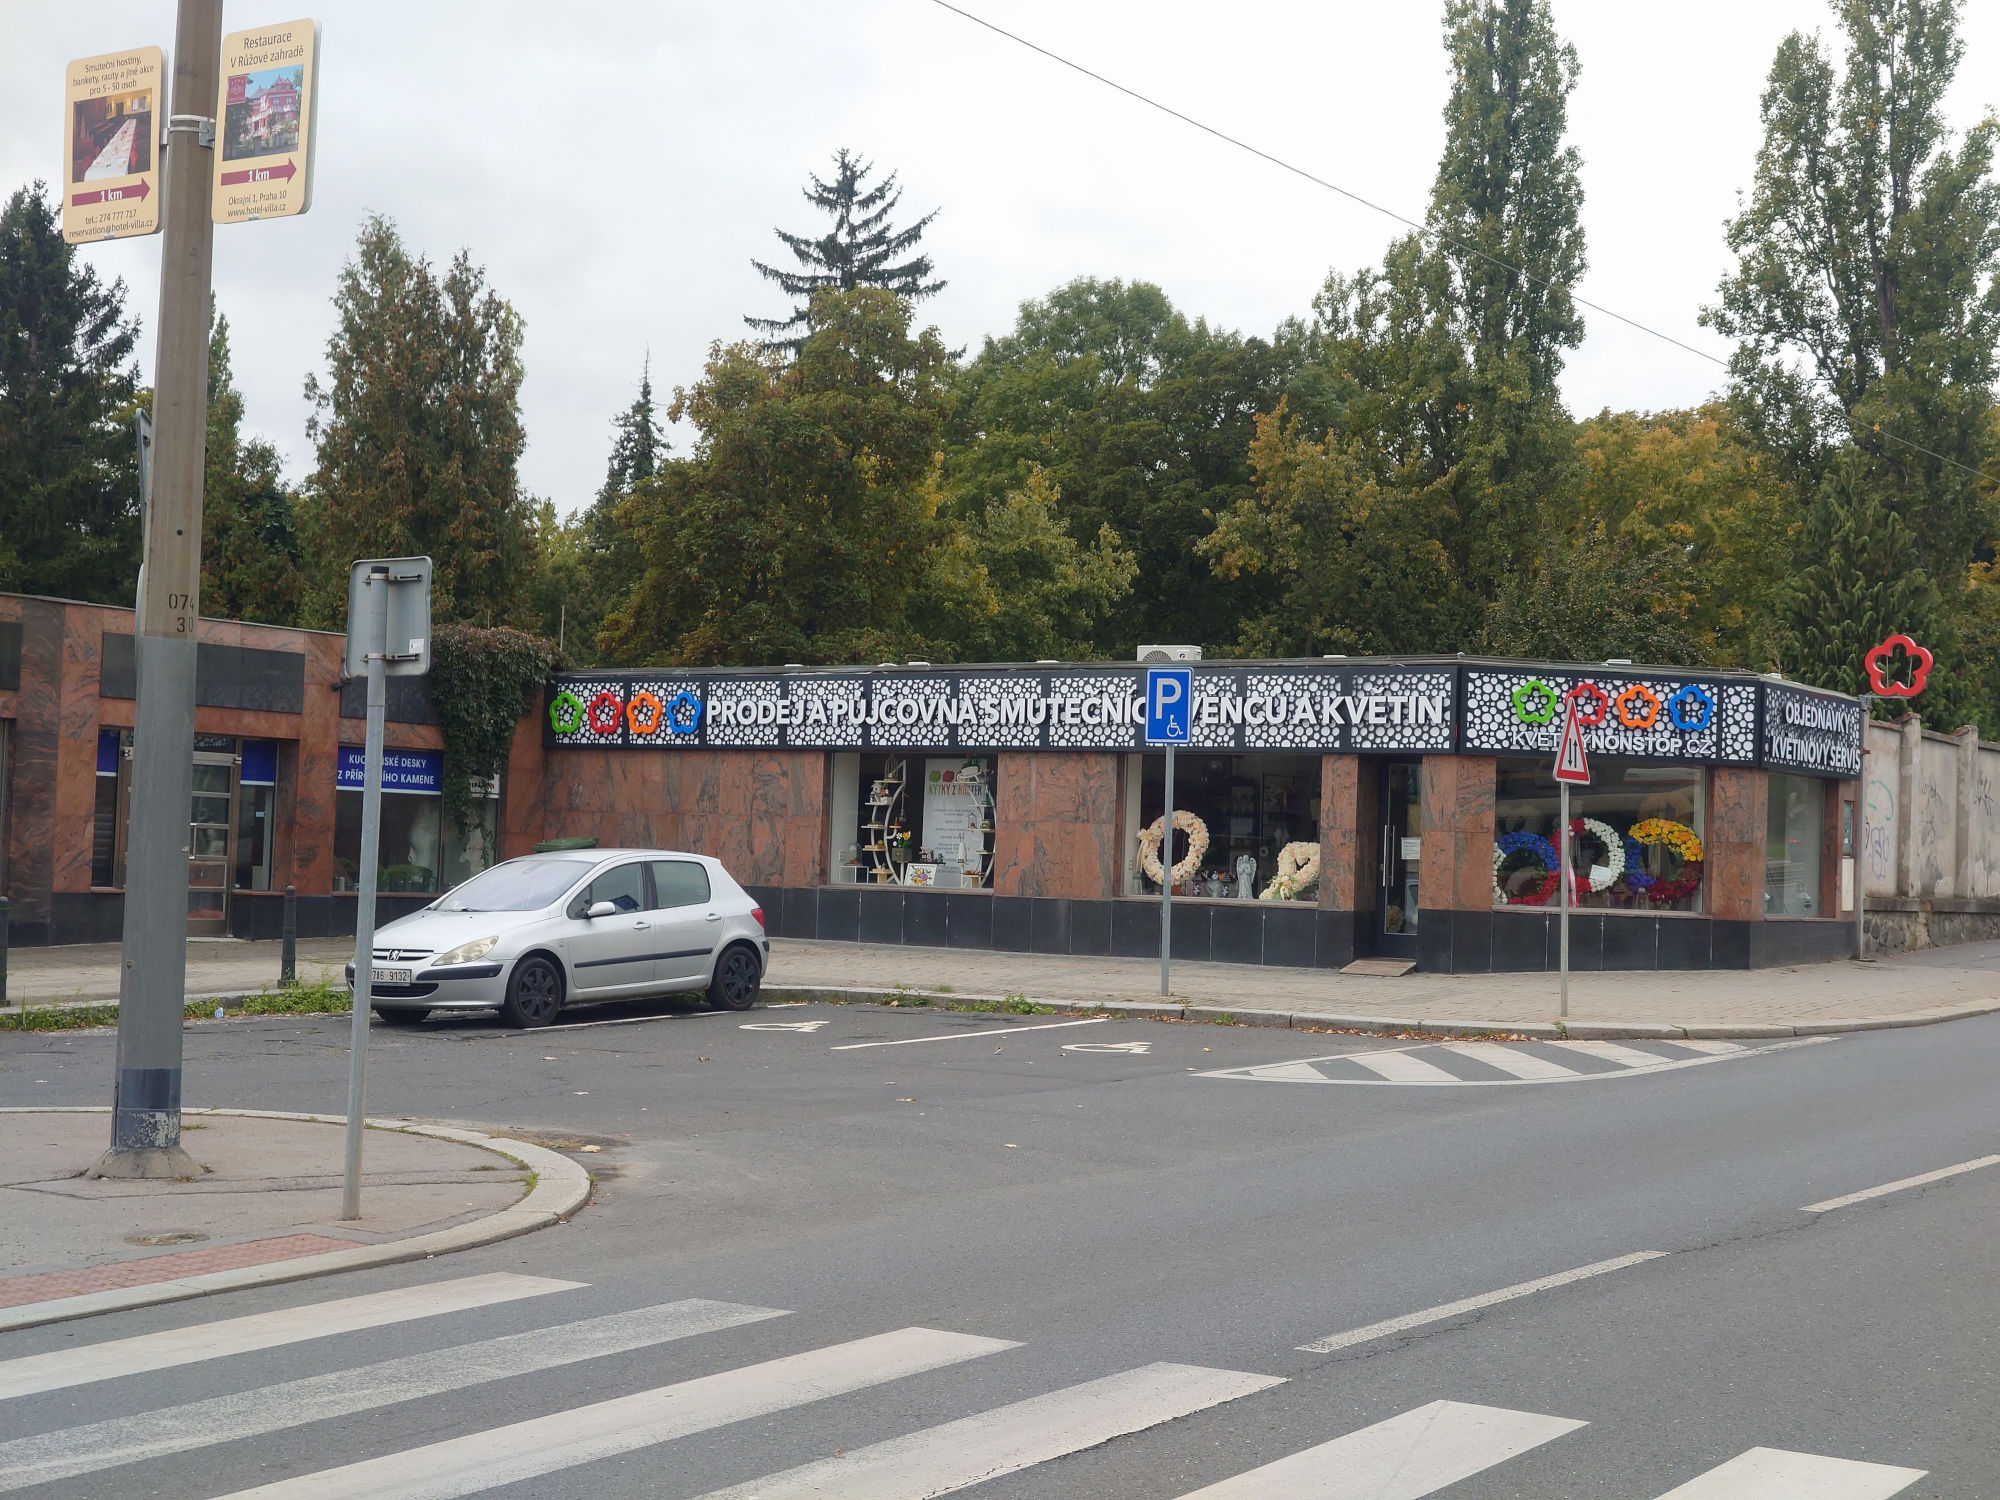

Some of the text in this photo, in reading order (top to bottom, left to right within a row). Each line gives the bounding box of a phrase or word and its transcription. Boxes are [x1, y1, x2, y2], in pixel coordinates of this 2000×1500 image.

[243, 32, 292, 50] Restaurace
[116, 56, 142, 68] hostiny,
[230, 45, 304, 68] V Růžové zahradě
[72, 75, 100, 87] bankety,
[101, 71, 119, 82] rauty
[139, 65, 155, 75] akce
[89, 87, 101, 97] pro
[102, 85, 107, 93] 5
[112, 81, 120, 91] 50
[121, 79, 137, 90] osob
[248, 168, 270, 182] 1 km
[100, 189, 123, 202] 1 km
[260, 191, 277, 201] Praha
[279, 190, 287, 199] 10
[99, 212, 111, 223] 274
[112, 210, 124, 221] 777
[126, 209, 137, 219] 717
[227, 203, 286, 217] www.hotel-villa.cz
[69, 219, 153, 238] reservation@hotel-villa.cz
[176, 616, 194, 633] 30
[706, 698, 805, 725] PRODEJ
[807, 697, 829, 725] A
[831, 690, 979, 725] PŮJČOVNA
[984, 689, 1146, 725] SMUTEČNÍC
[1291, 696, 1319, 725] A
[1322, 687, 1444, 725] KVĚTIN
[1155, 677, 1182, 720] P
[1512, 731, 1712, 755] KVETYNONSTOP.CZ
[1772, 732, 1861, 771] KVĚTINOVÝ SERVIS
[401, 757, 427, 769] DESKY
[337, 768, 434, 785] Z PŘÍRÍHO KAMENE
[928, 783, 951, 796] KYTKY
[952, 784, 957, 796] Z
[389, 971, 407, 982] 9132
